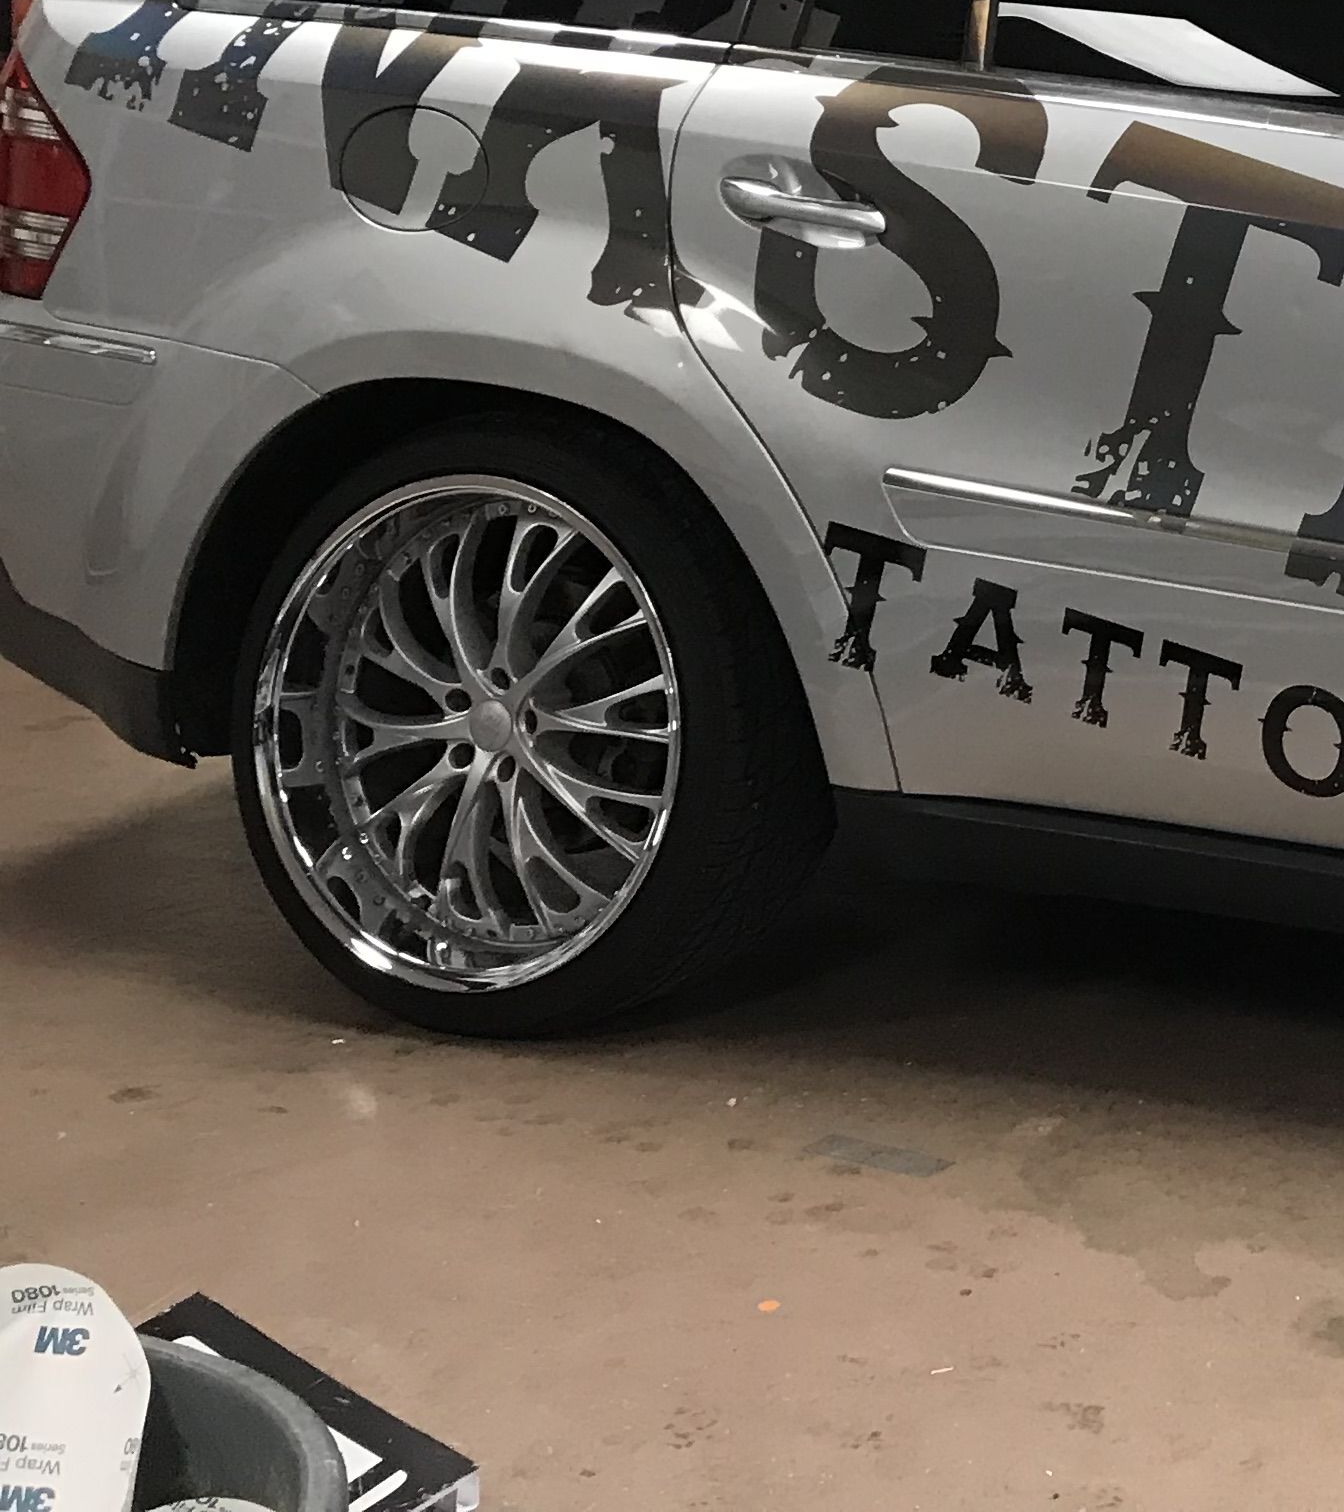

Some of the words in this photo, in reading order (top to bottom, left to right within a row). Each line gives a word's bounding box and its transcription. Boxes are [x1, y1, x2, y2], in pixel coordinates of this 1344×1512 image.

[12, 1284, 61, 1304] 1080
[11, 1299, 47, 1315] Film
[52, 1301, 94, 1316] Wrap
[34, 1325, 90, 1356] 3M
[15, 1458, 61, 1476] Wrap
